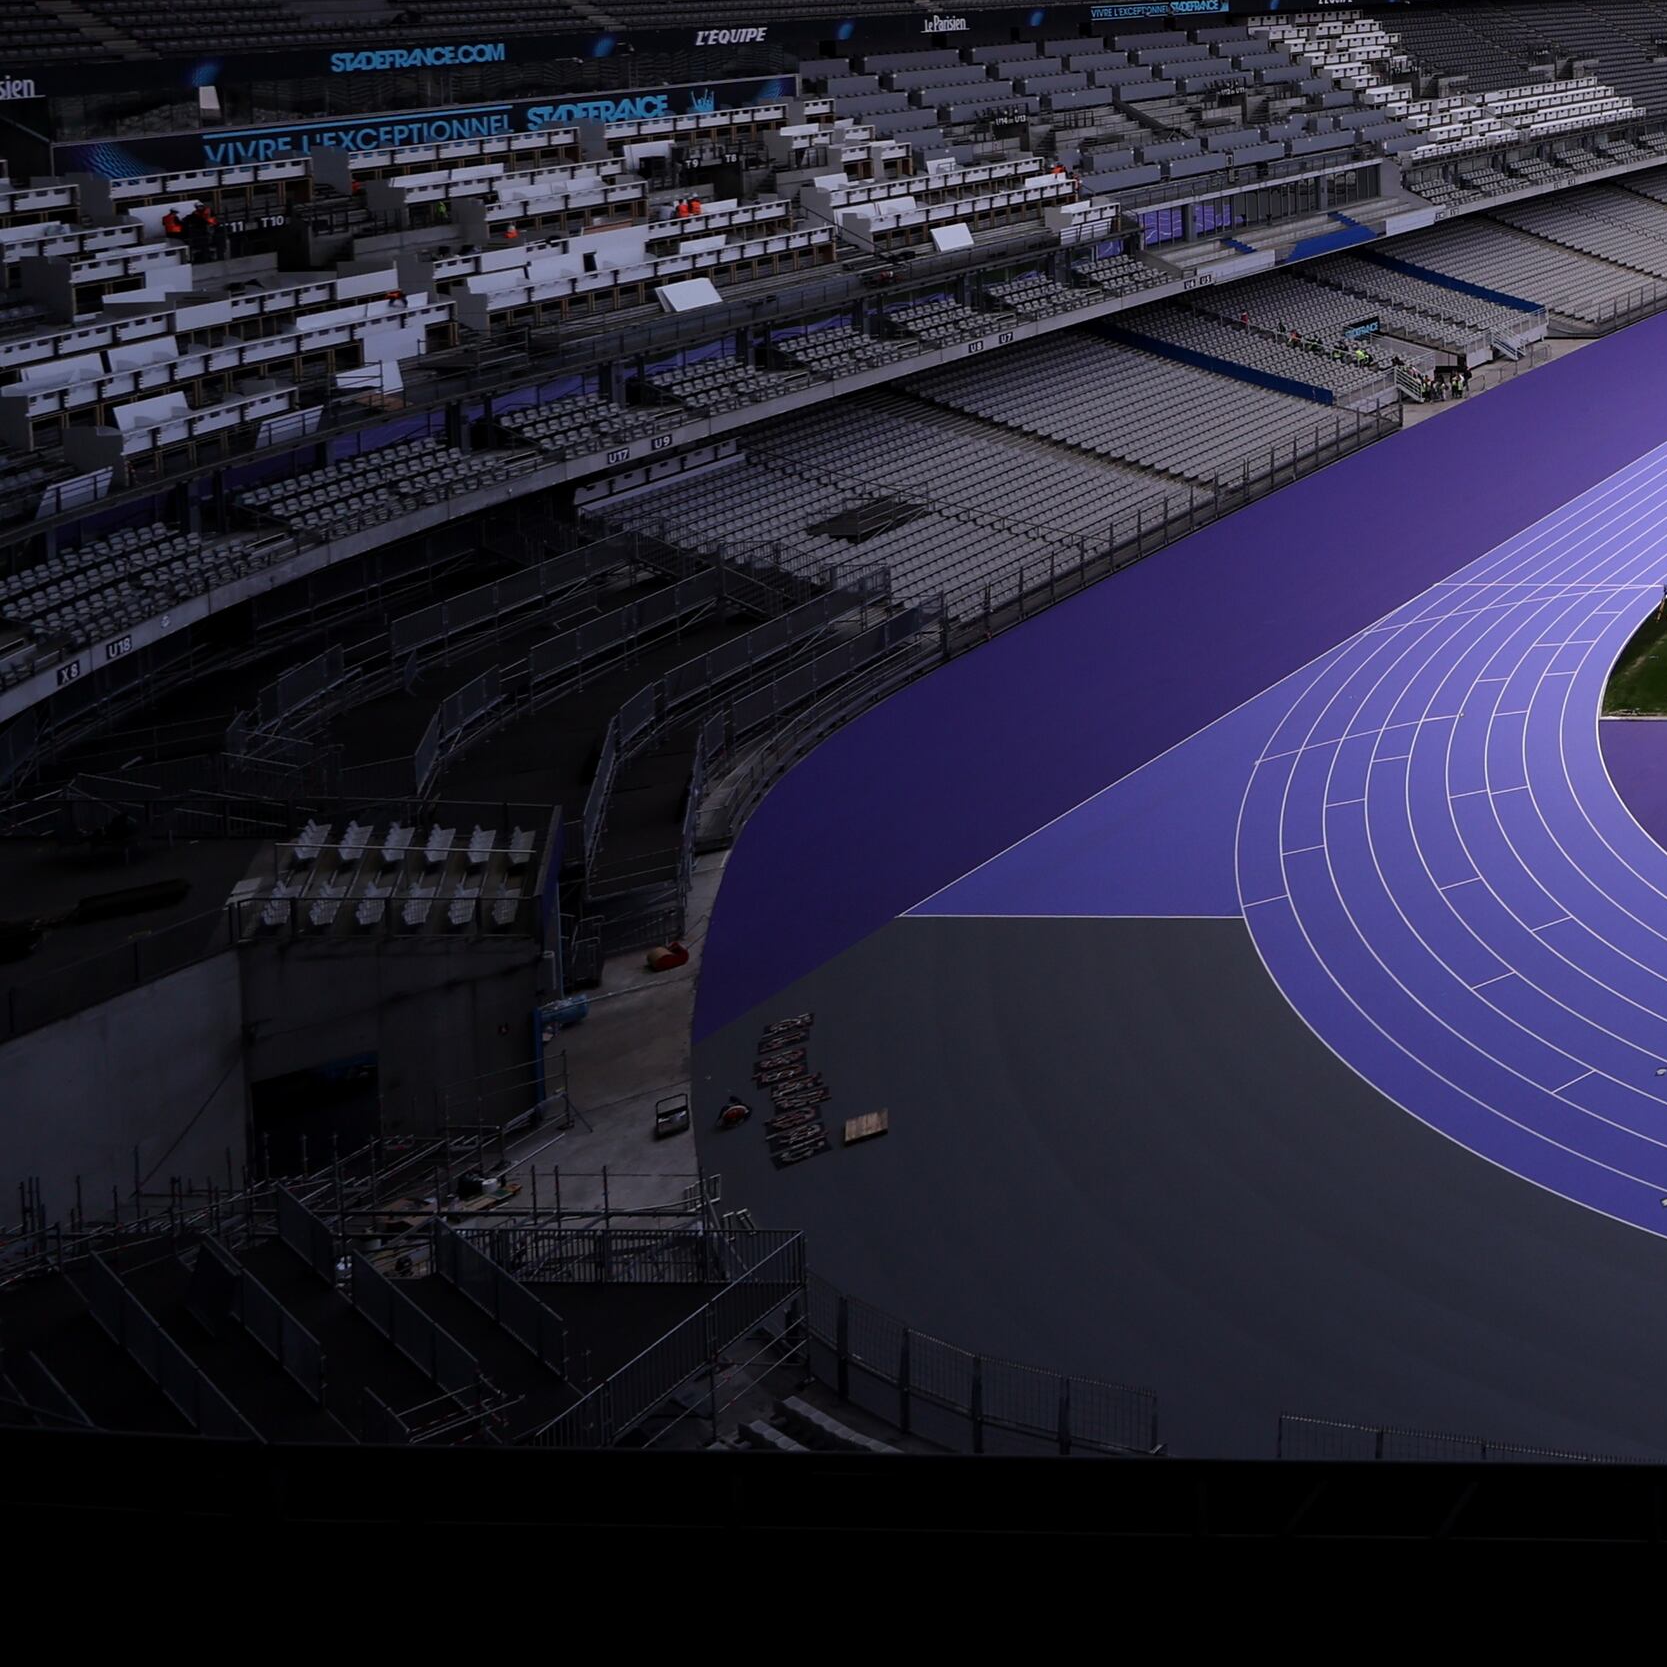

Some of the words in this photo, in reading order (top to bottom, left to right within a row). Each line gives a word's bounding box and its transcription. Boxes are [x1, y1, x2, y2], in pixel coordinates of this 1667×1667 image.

[331, 42, 505, 73] STADEFRANCE.COM
[203, 136, 292, 165] VIVRE
[685, 158, 699, 170] T9
[224, 221, 244, 234] 11
[260, 214, 285, 229] T10
[608, 449, 628, 464] U17
[653, 435, 671, 450] U9
[59, 661, 79, 685] X8
[107, 637, 131, 658] U18
